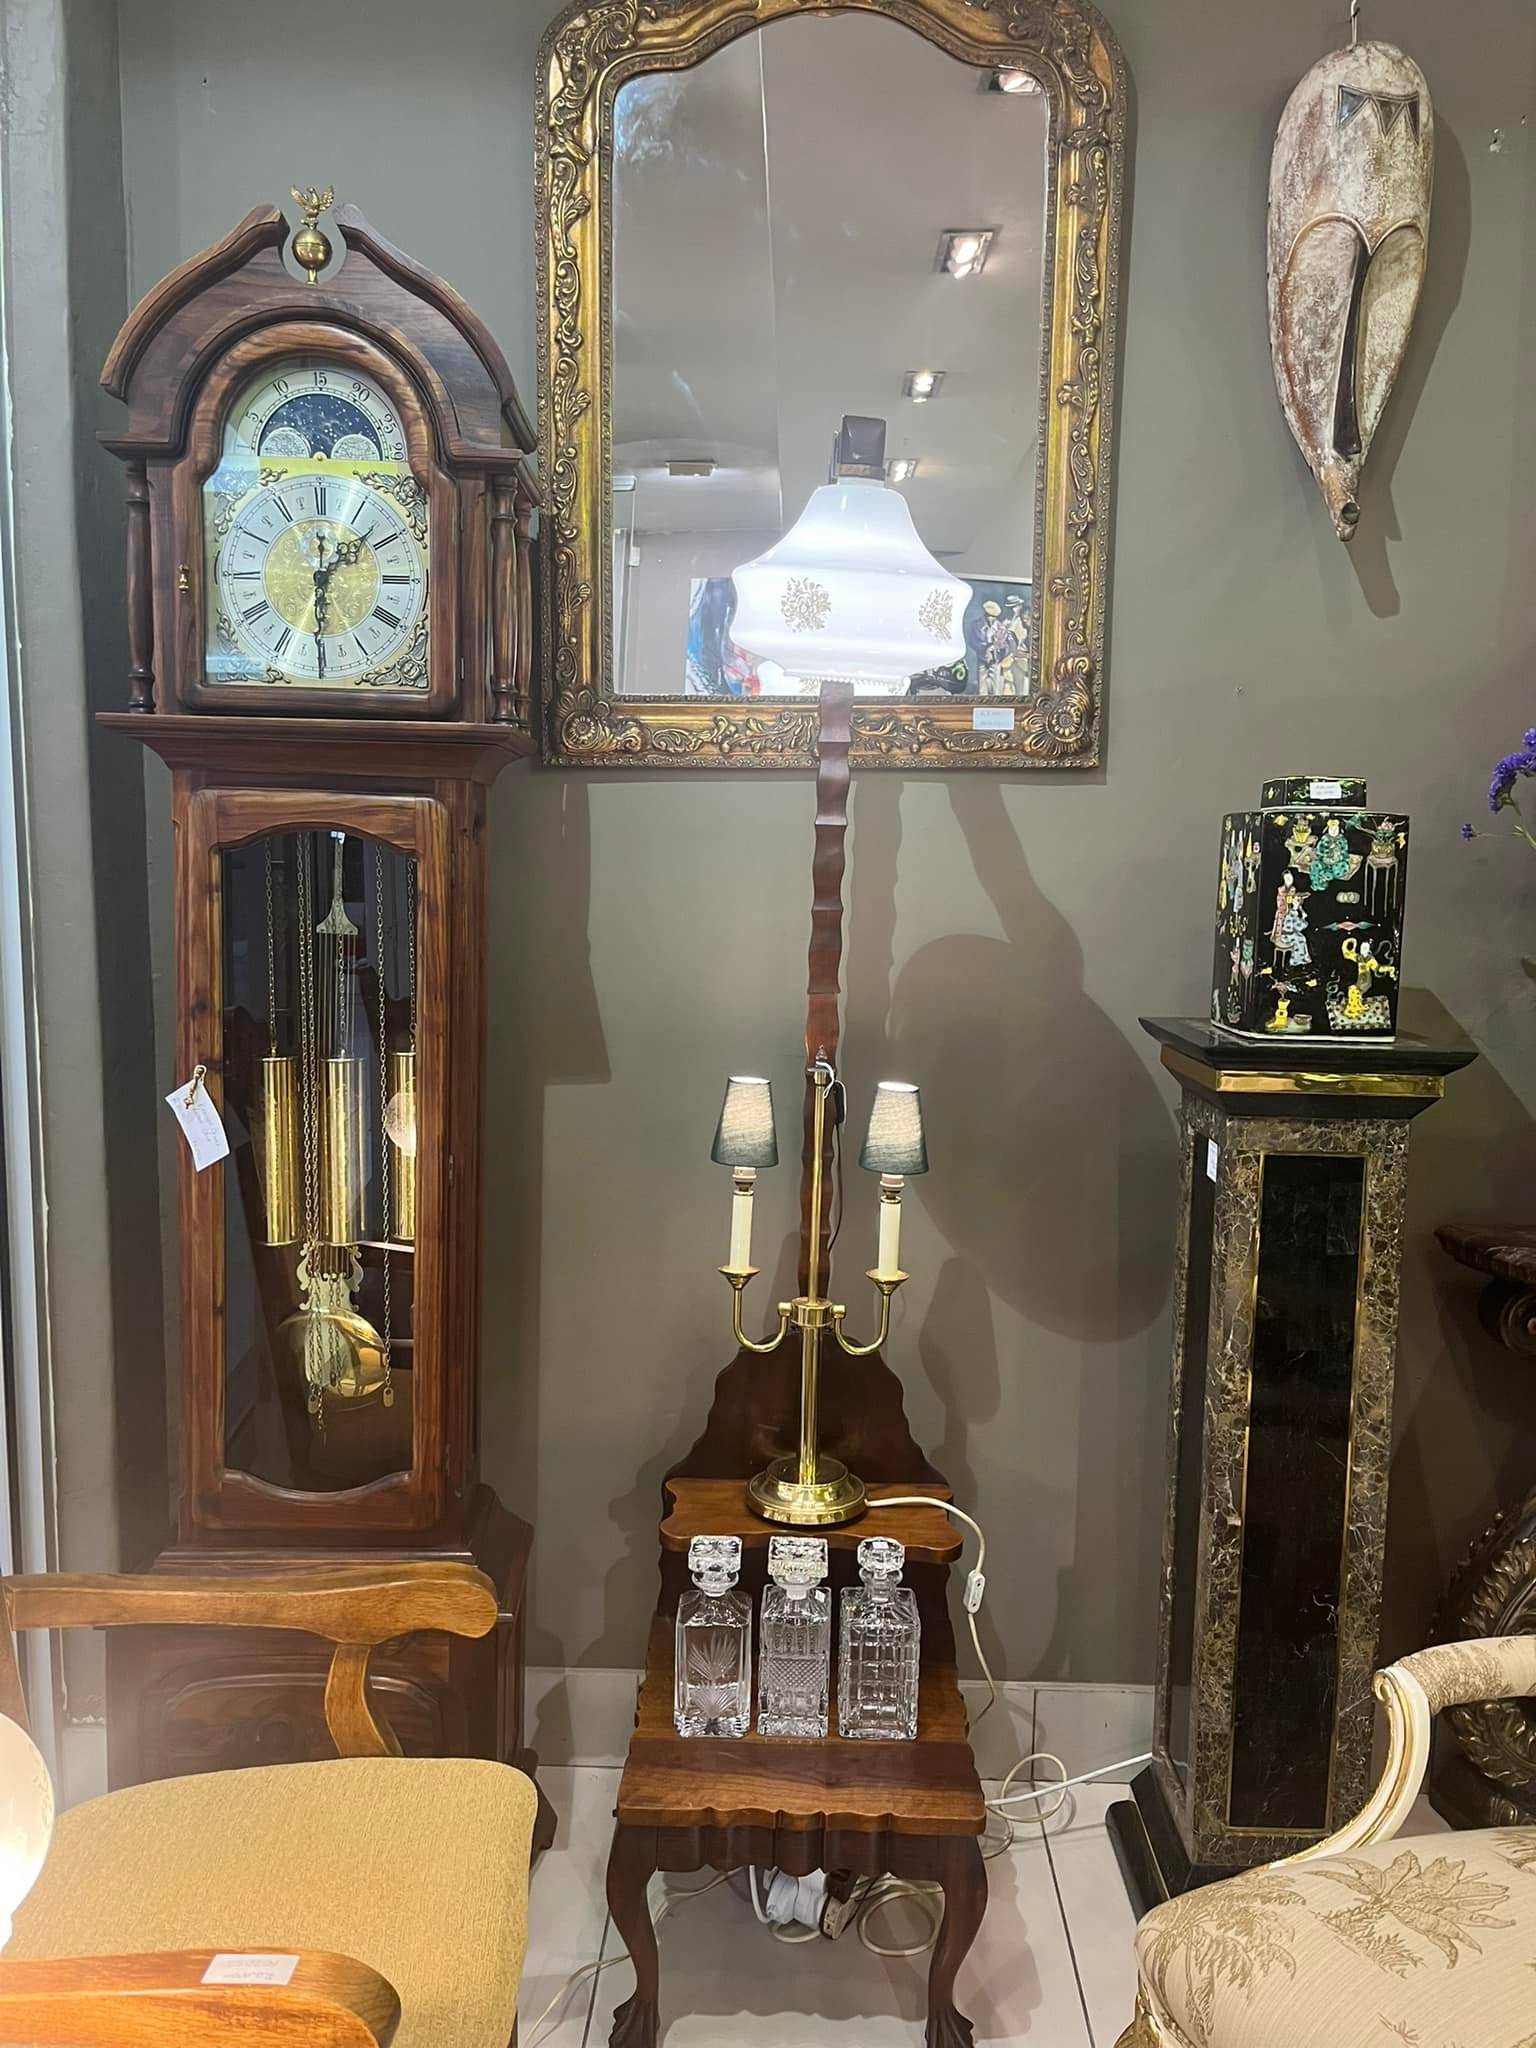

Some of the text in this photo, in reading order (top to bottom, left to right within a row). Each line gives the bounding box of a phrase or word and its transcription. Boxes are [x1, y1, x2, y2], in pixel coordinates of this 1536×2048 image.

[313, 371, 327, 387] 15
[272, 379, 289, 397] 10
[351, 382, 371, 402] 20
[245, 411, 259, 423] 5
[379, 413, 397, 434] 25
[382, 574, 410, 585] III
